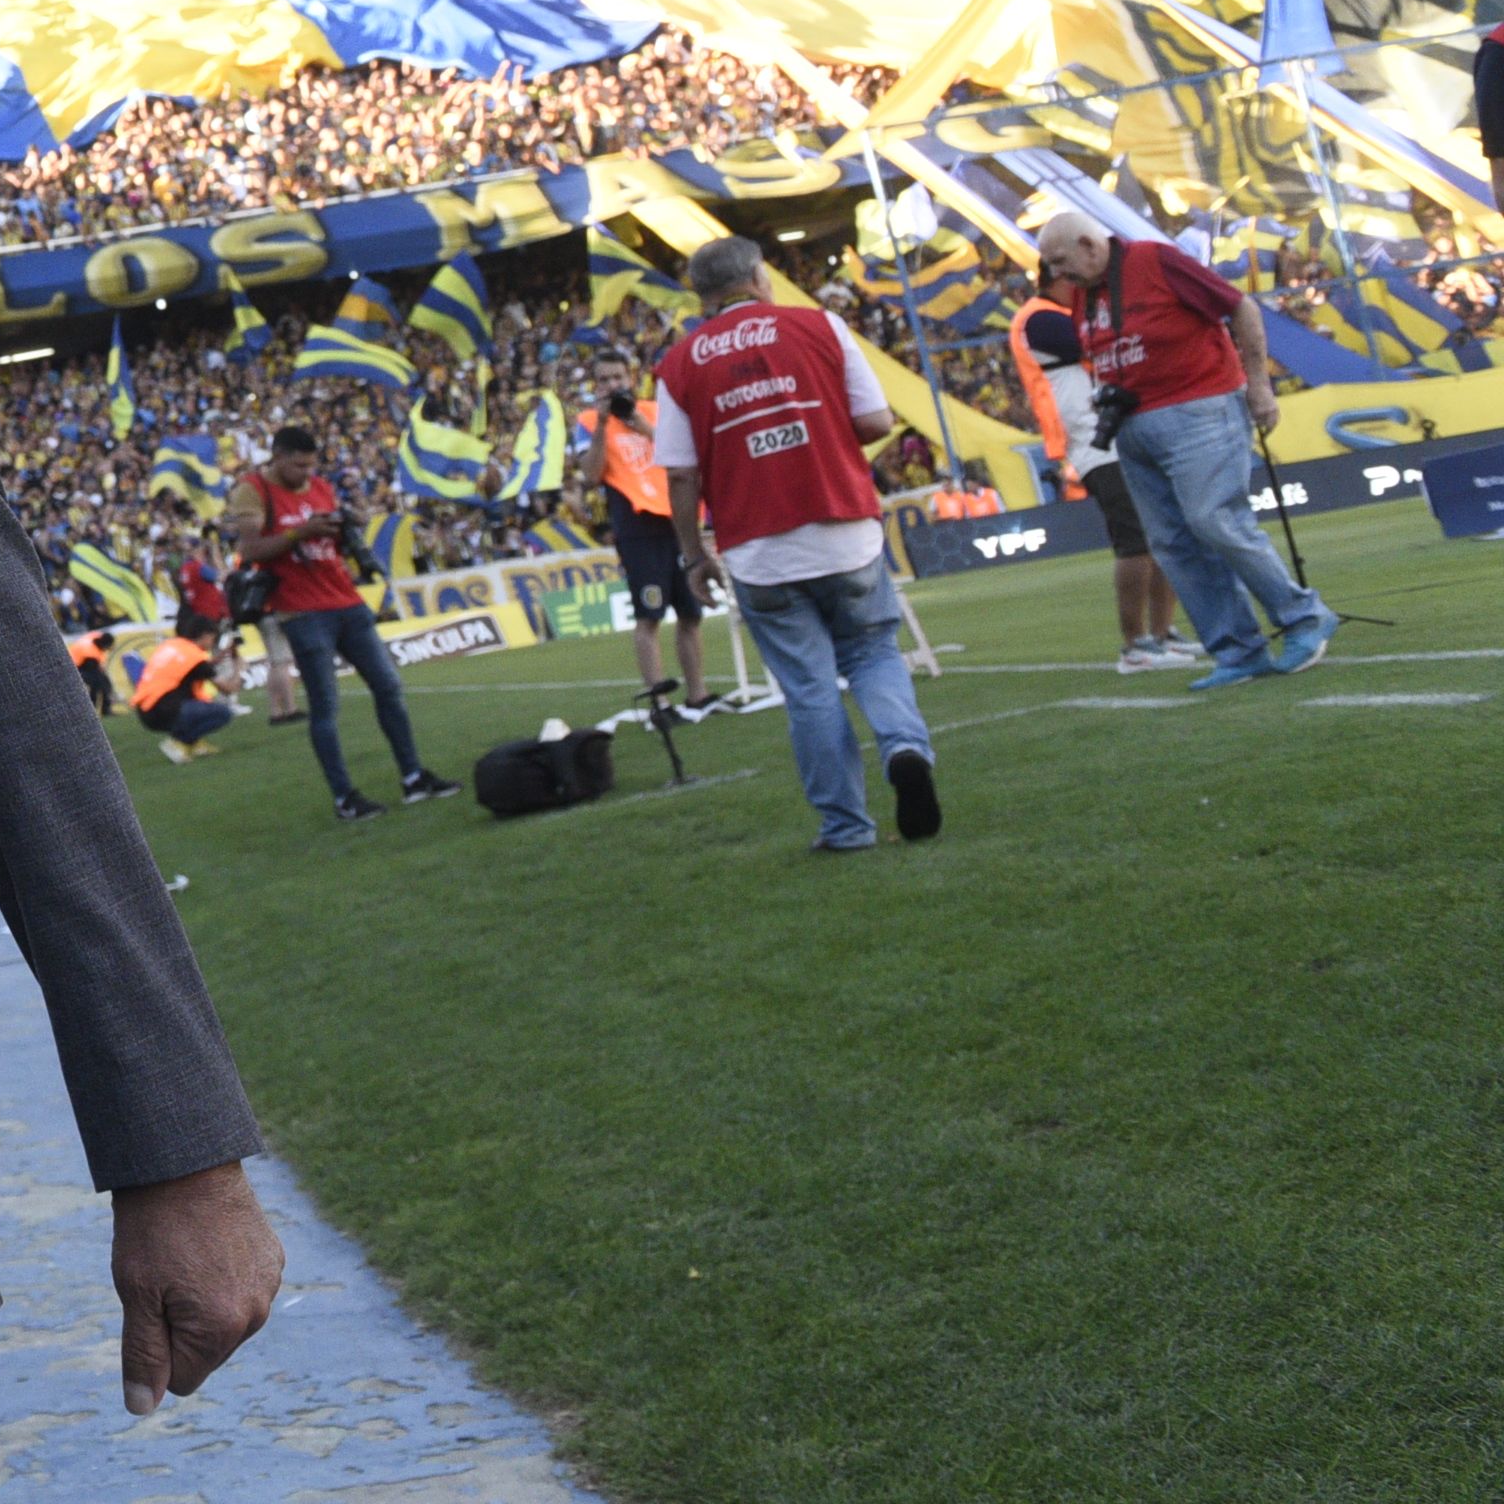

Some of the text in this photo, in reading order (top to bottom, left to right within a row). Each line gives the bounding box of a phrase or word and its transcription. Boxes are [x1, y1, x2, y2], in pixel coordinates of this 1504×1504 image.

[691, 316, 778, 365] Coca-Cola
[751, 424, 804, 454] 2020
[972, 527, 1048, 559] YPF
